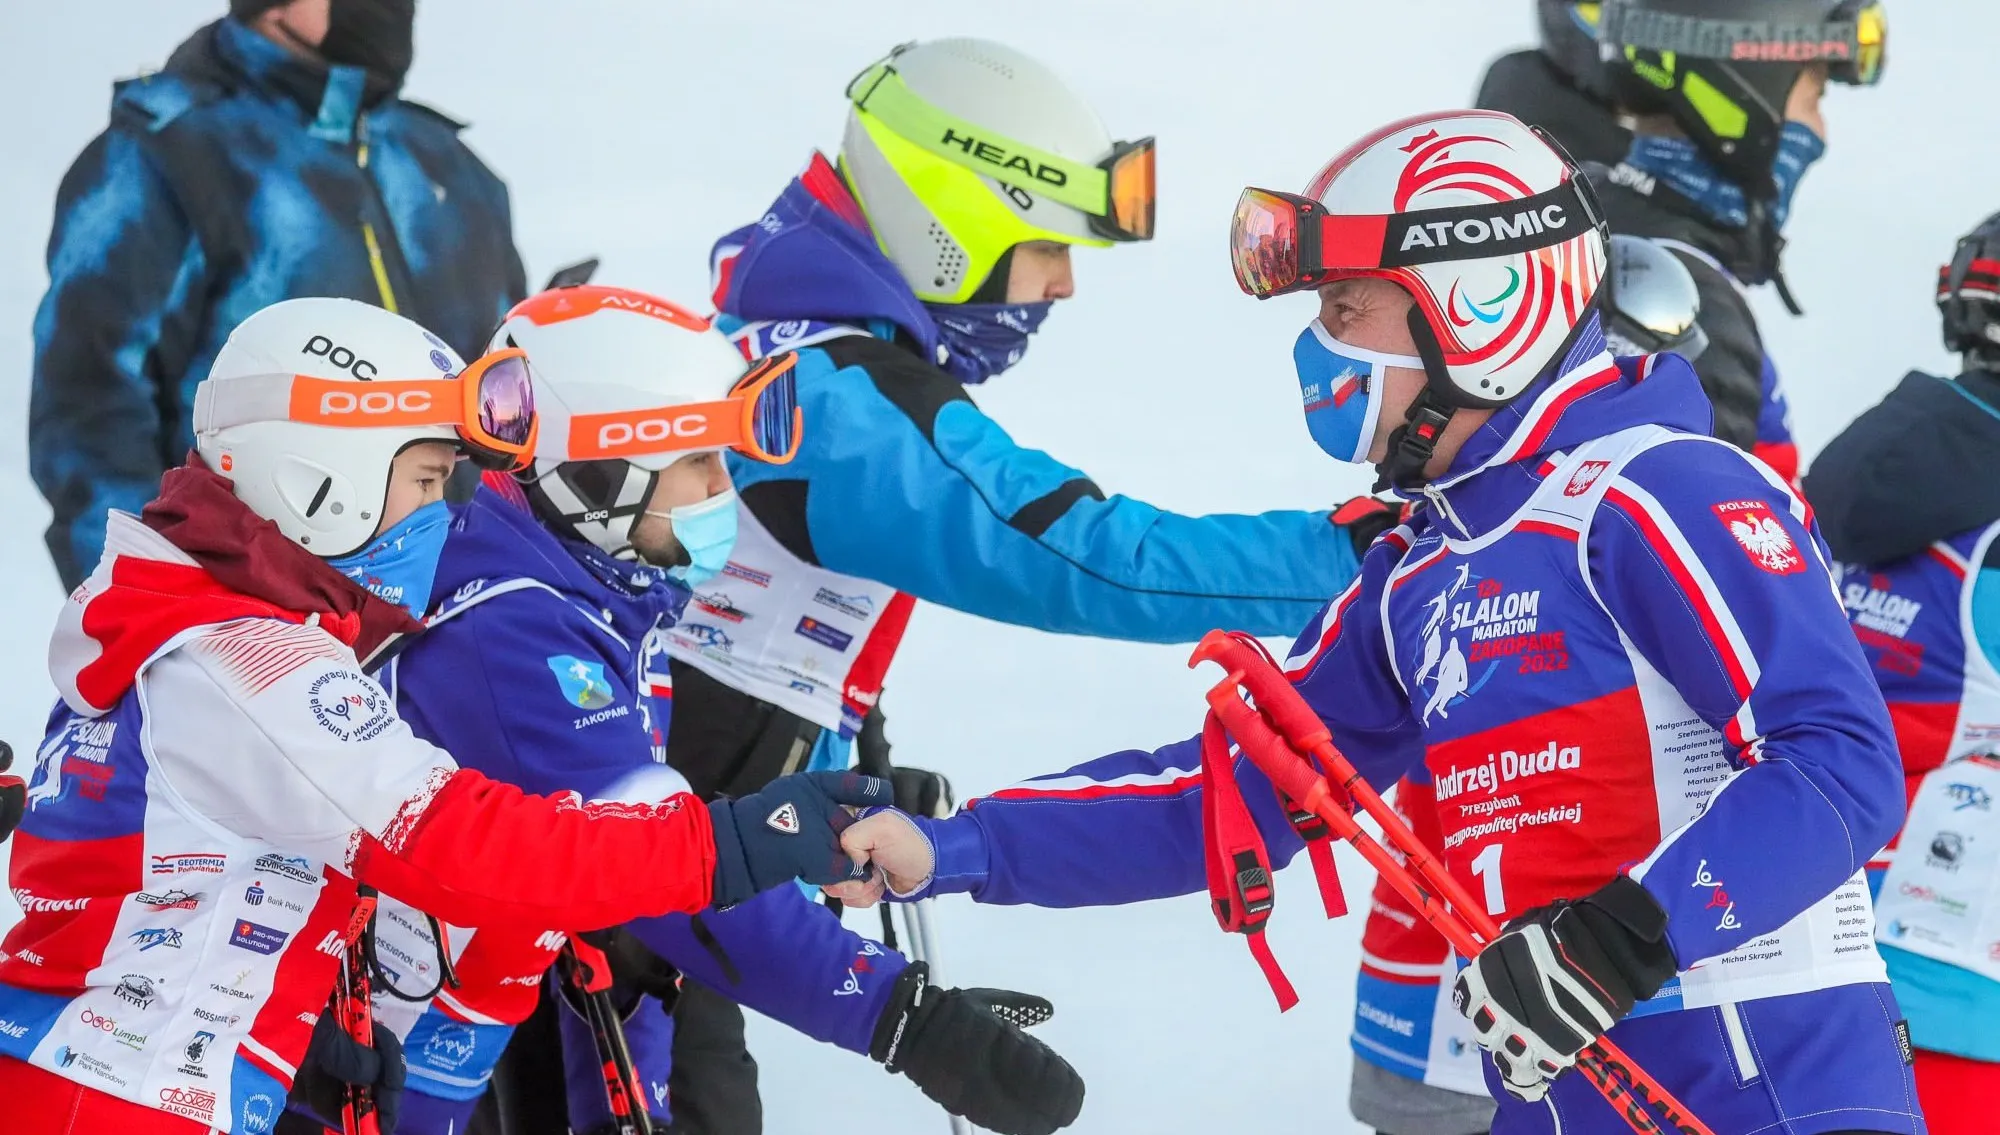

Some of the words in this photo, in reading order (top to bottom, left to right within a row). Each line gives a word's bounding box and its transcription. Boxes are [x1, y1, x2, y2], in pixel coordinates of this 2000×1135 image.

[941, 128, 1067, 187] HEAD
[1400, 203, 1567, 252] ATOMIC
[1718, 500, 1765, 512] POLSKA
[1450, 591, 1540, 631] SLALOM
[1471, 618, 1537, 642] MARATON
[1469, 631, 1567, 663] ZAKOPANE
[1518, 652, 1570, 674] 2022
[308, 669, 349, 695] Integracji
[351, 673, 380, 696] Przez
[309, 698, 350, 741] Fundacja
[72, 720, 118, 748] SLALOM
[1677, 728, 1710, 739] Stefania
[1664, 742, 1707, 754] Magdalena
[1685, 752, 1708, 762] Agata
[1435, 753, 1499, 802] Andrzej
[1500, 741, 1581, 782] Duda
[1683, 763, 1713, 775] Andrzej
[1687, 775, 1718, 786] Mariusz
[1459, 794, 1522, 817] Prezydent
[1519, 803, 1582, 827] Polskiej
[178, 856, 225, 867] GEOTERMIA
[256, 859, 318, 883] SZYMOSZKOWA
[1471, 843, 1506, 916] 1
[267, 895, 283, 906] Bank
[285, 901, 304, 914] Polski
[387, 911, 413, 932] TATRA
[1758, 938, 1780, 948] Zięba
[1721, 954, 1747, 965] Michał
[1748, 950, 1783, 962] Skrzypek
[113, 984, 155, 1011] TATRY
[112, 1028, 148, 1044] Limpol
[1897, 1024, 1913, 1062] BERDAX
[78, 1060, 92, 1071] Park
[94, 1067, 127, 1088] Narodowy
[81, 1053, 112, 1072] Tatrzański
[185, 1063, 203, 1072] POWIAT
[160, 1103, 214, 1121] ZAKOPANE
